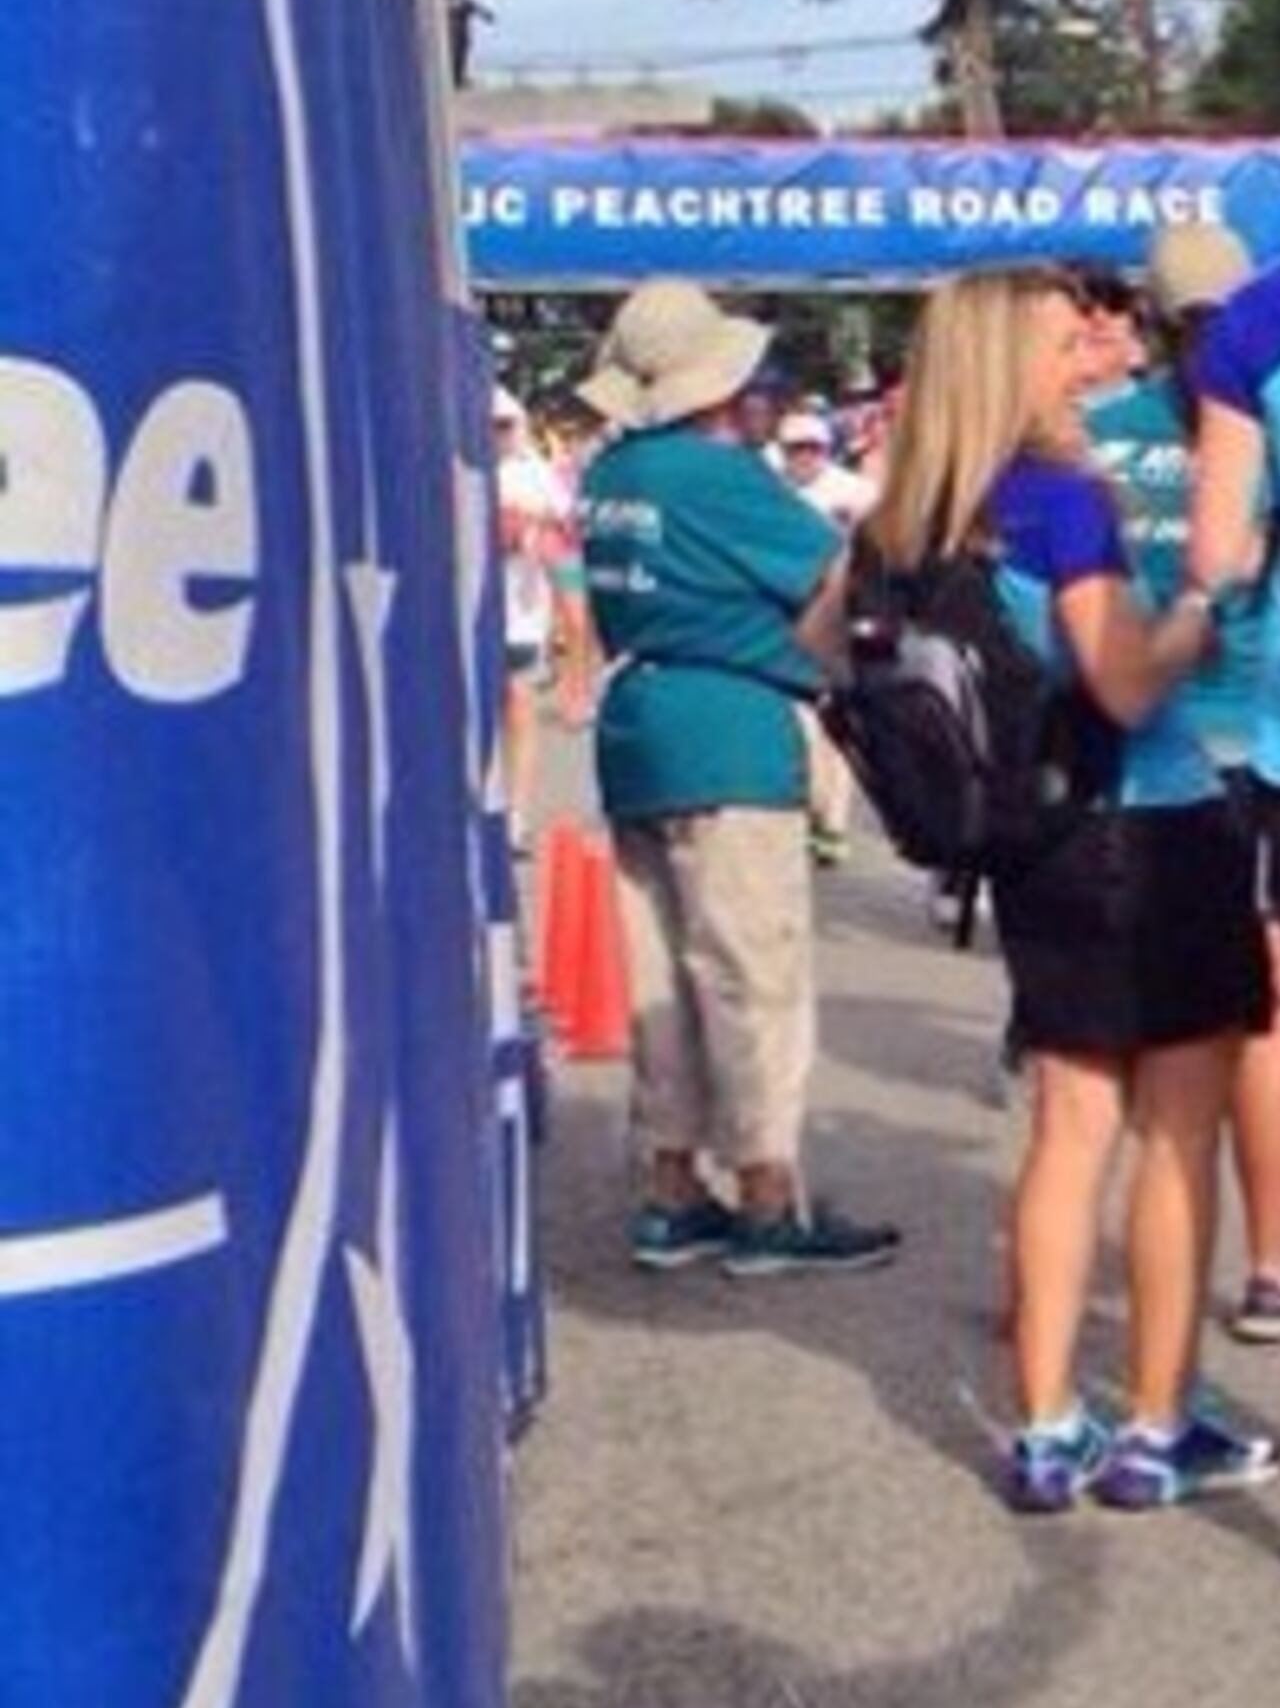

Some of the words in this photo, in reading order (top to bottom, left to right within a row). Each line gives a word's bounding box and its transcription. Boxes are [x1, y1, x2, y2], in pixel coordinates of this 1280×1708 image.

[553, 185, 885, 230] PEACHTREE
[909, 186, 1061, 230] ROAD
[1084, 186, 1224, 229] RACE
